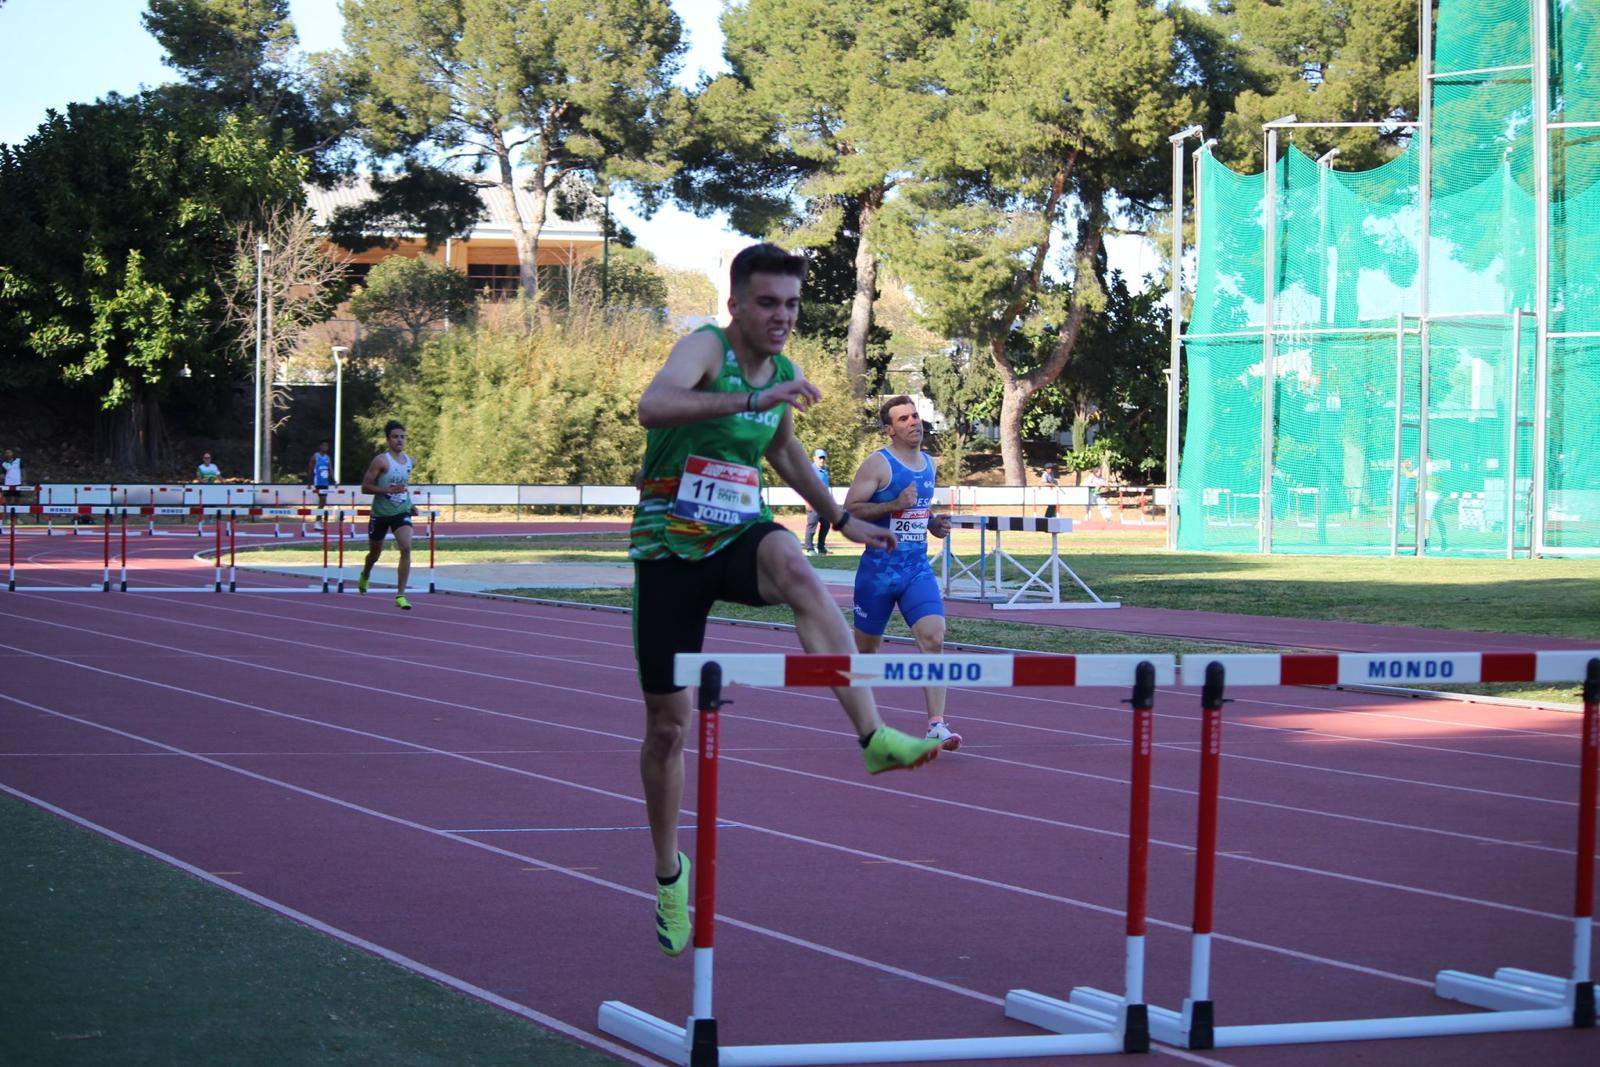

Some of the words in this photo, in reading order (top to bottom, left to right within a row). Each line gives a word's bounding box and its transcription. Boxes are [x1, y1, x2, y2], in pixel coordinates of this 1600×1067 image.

[736, 411, 779, 428] esco
[693, 480, 716, 502] 11
[895, 521, 910, 532] 26
[884, 663, 981, 681] MONDO
[1369, 660, 1453, 678] MONDO
